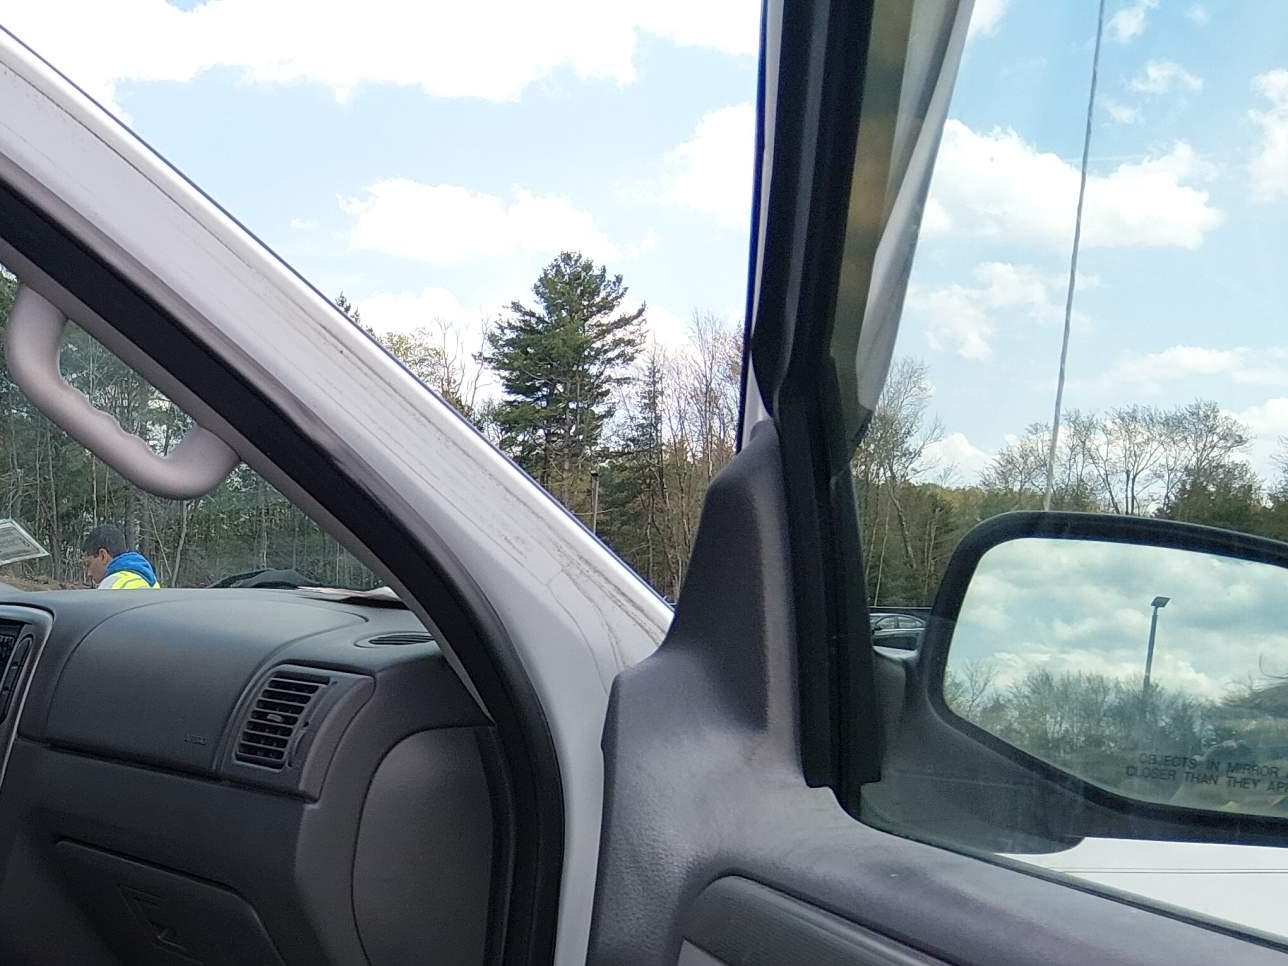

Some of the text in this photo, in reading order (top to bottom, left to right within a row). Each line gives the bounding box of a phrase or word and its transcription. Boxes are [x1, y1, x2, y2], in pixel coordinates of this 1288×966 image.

[1140, 753, 1197, 769] OBJECTS
[1206, 759, 1220, 771] IN
[1227, 762, 1279, 777] MIRROR
[1125, 766, 1176, 781] CLOSER
[1184, 771, 1218, 784] THAN
[1227, 775, 1261, 789] THEY
